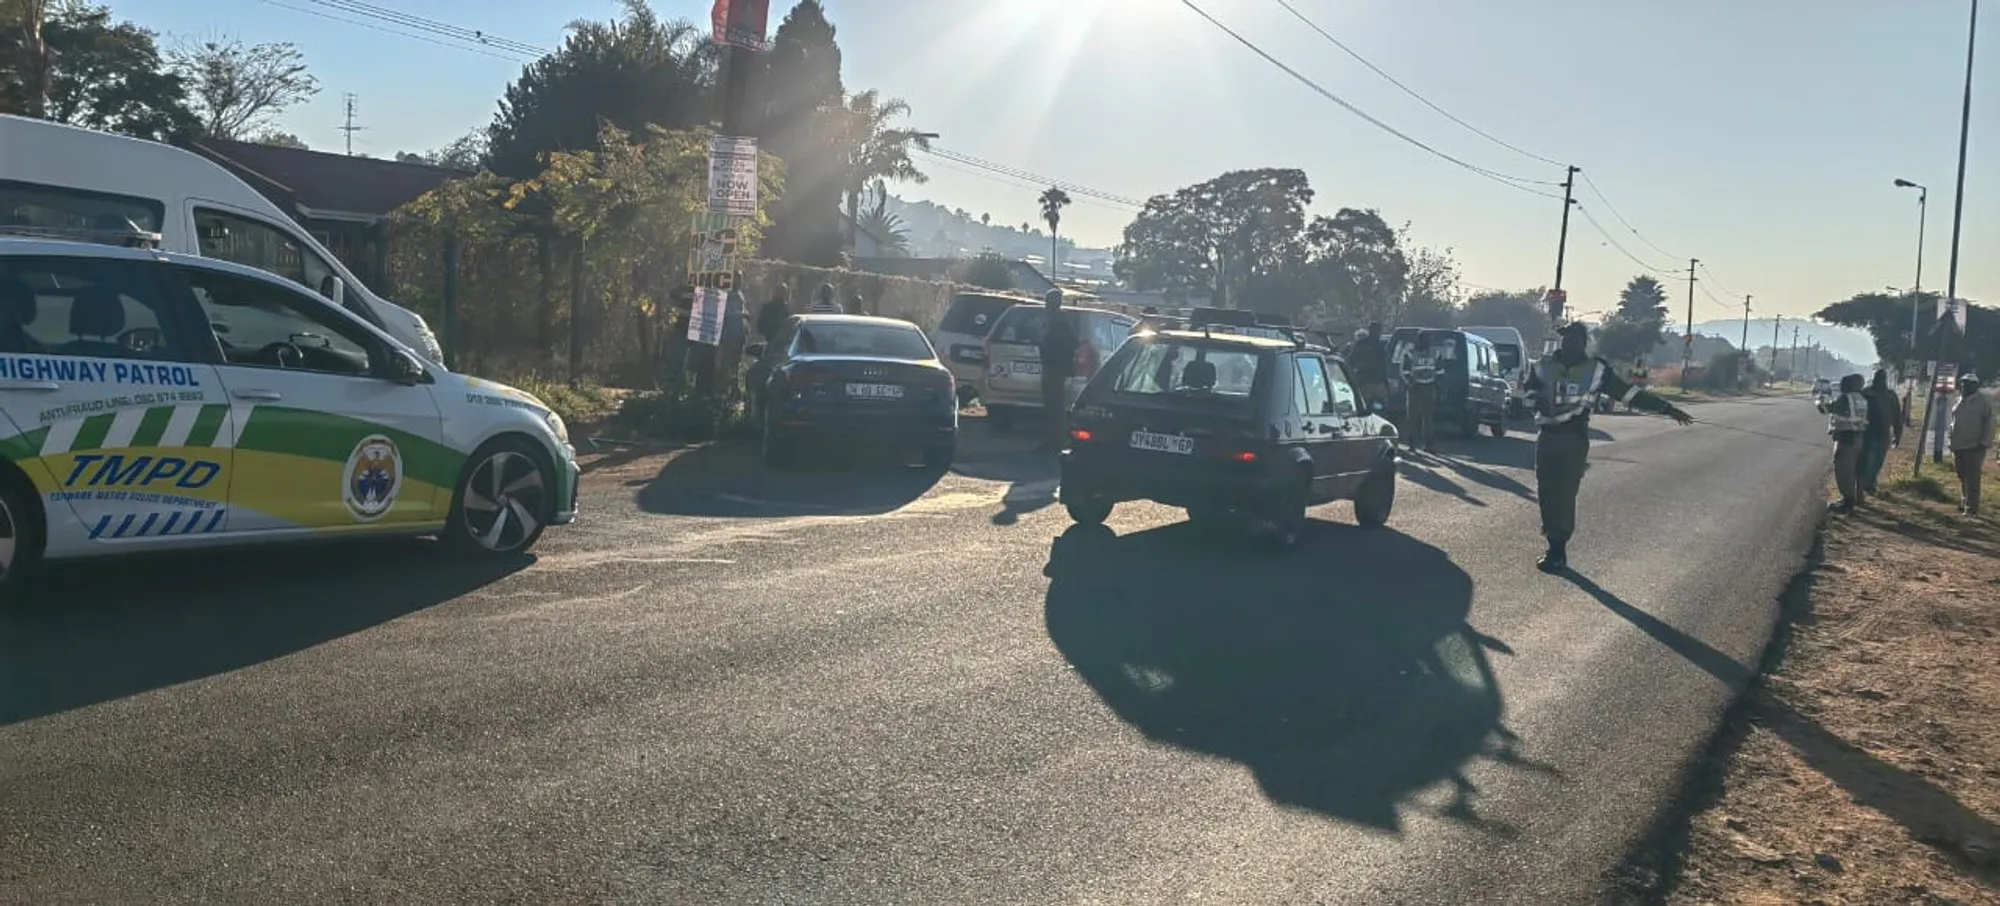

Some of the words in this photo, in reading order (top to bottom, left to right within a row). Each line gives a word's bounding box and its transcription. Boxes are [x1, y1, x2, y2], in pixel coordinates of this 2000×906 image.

[716, 180, 749, 190] NOW
[716, 189, 750, 200] OPEN
[113, 363, 200, 386] PATROL
[39, 399, 104, 421] ANTI-FRAUD
[64, 455, 221, 489] TMPD
